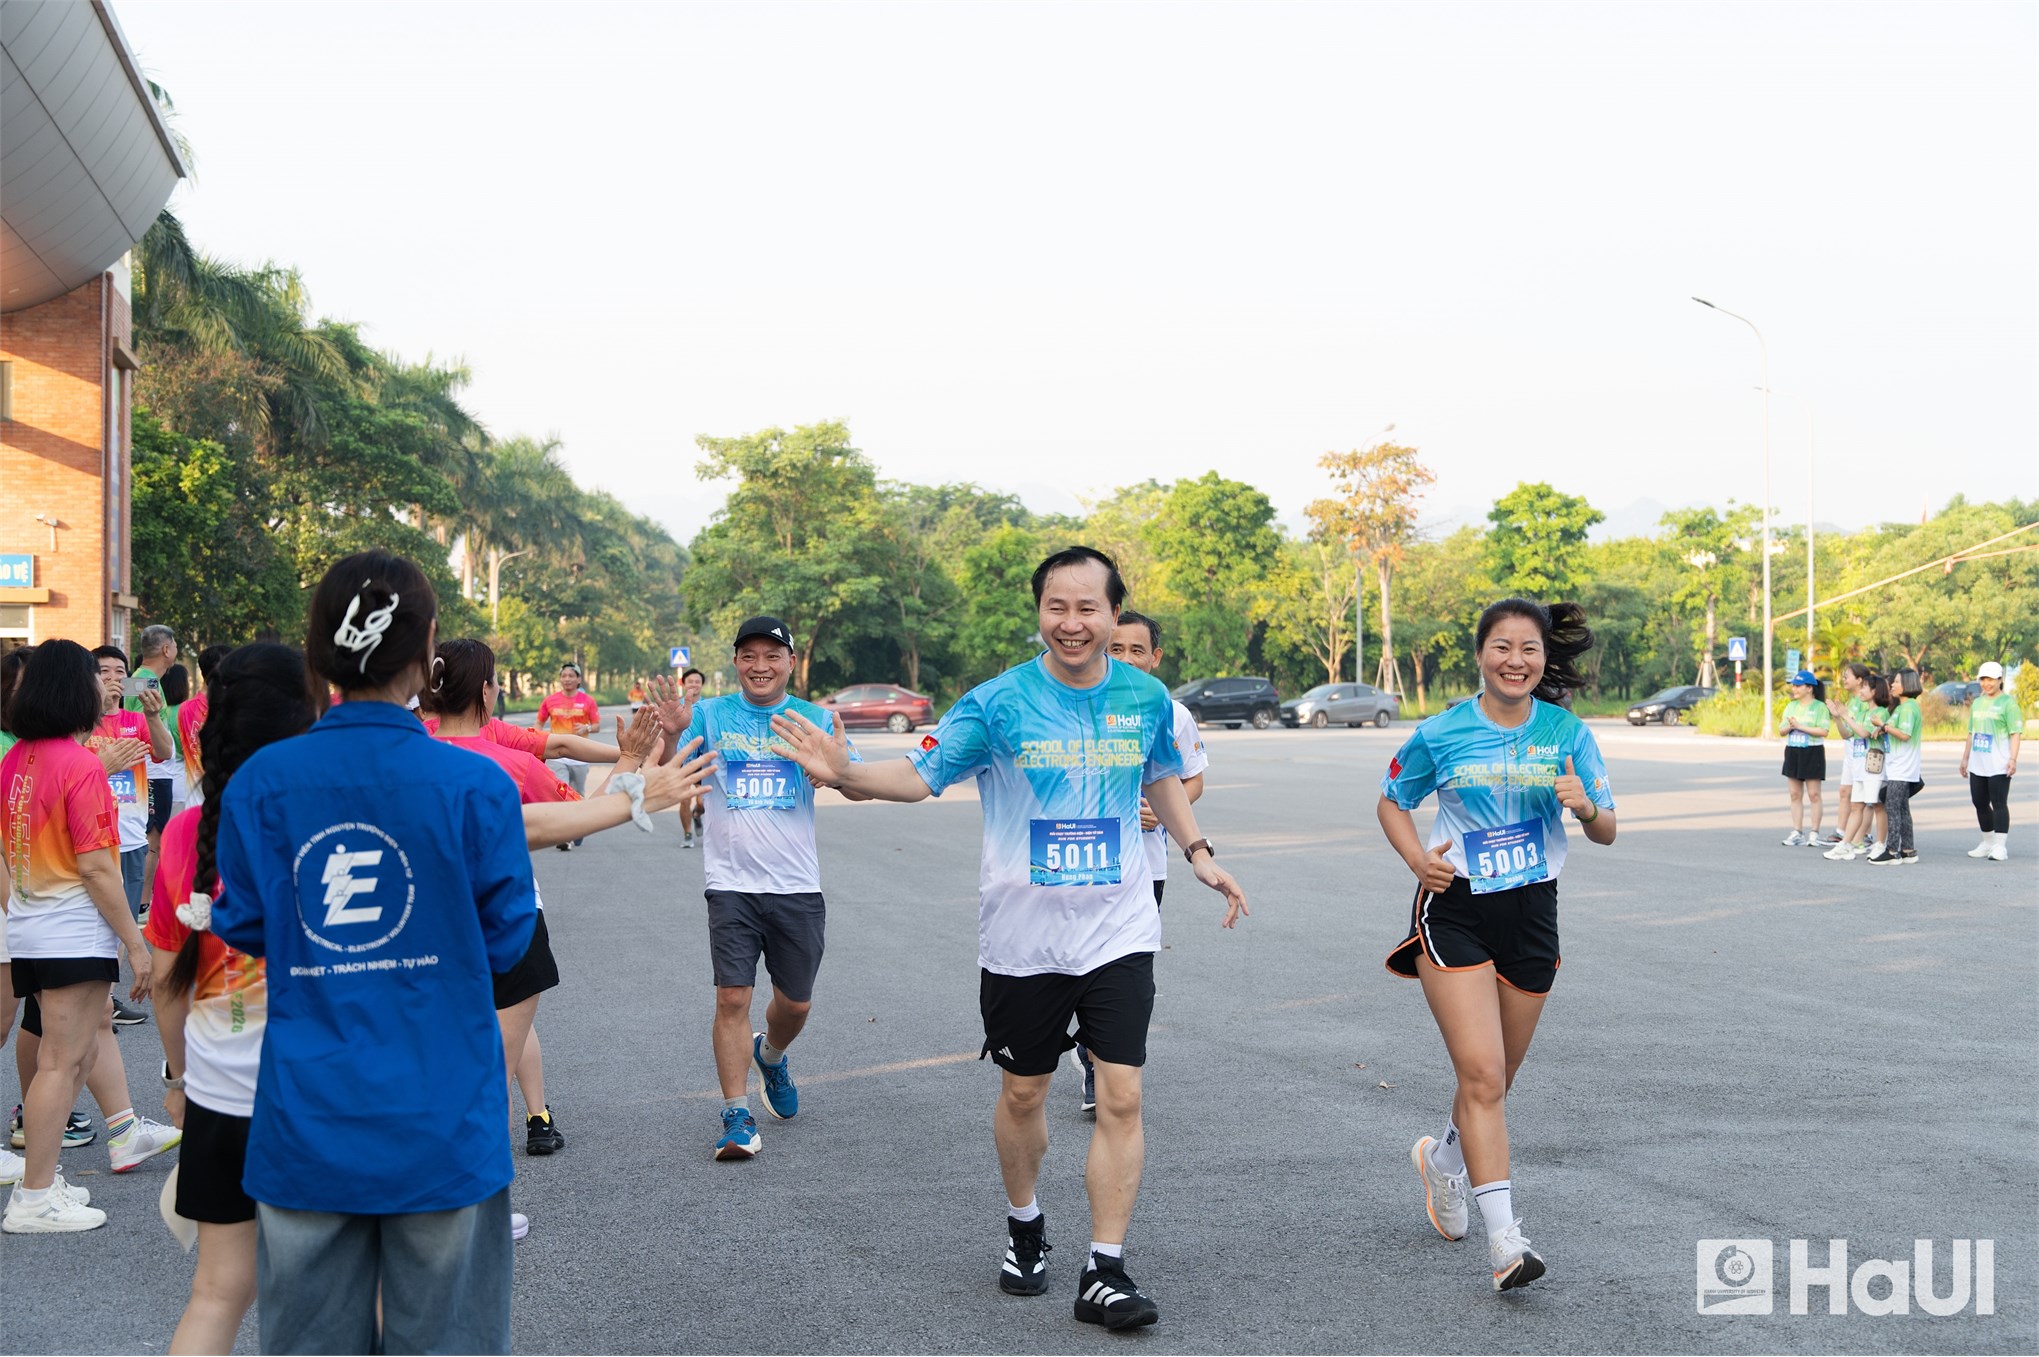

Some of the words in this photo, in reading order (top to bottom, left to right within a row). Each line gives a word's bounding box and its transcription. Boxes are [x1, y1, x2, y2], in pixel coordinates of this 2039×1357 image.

[1117, 714, 1141, 727] HaUI
[1021, 740, 1065, 754] SCHOOL
[1068, 740, 1082, 753] OF
[1085, 739, 1141, 753] ELECTRICAL
[1537, 744, 1559, 755] HaUI
[1062, 754, 1110, 783] Race
[1454, 763, 1491, 777] SCHOOL
[1492, 763, 1504, 776] OF
[736, 777, 786, 797] 5007
[1487, 775, 1530, 800] Race
[1047, 842, 1107, 870] 5011
[1478, 842, 1538, 878] 5003
[332, 961, 366, 975] TRÁCH
[367, 958, 397, 971] NHIỆM
[402, 957, 415, 970] TỰ
[416, 954, 439, 968] HÀO
[231, 1000, 246, 1033] 2026
